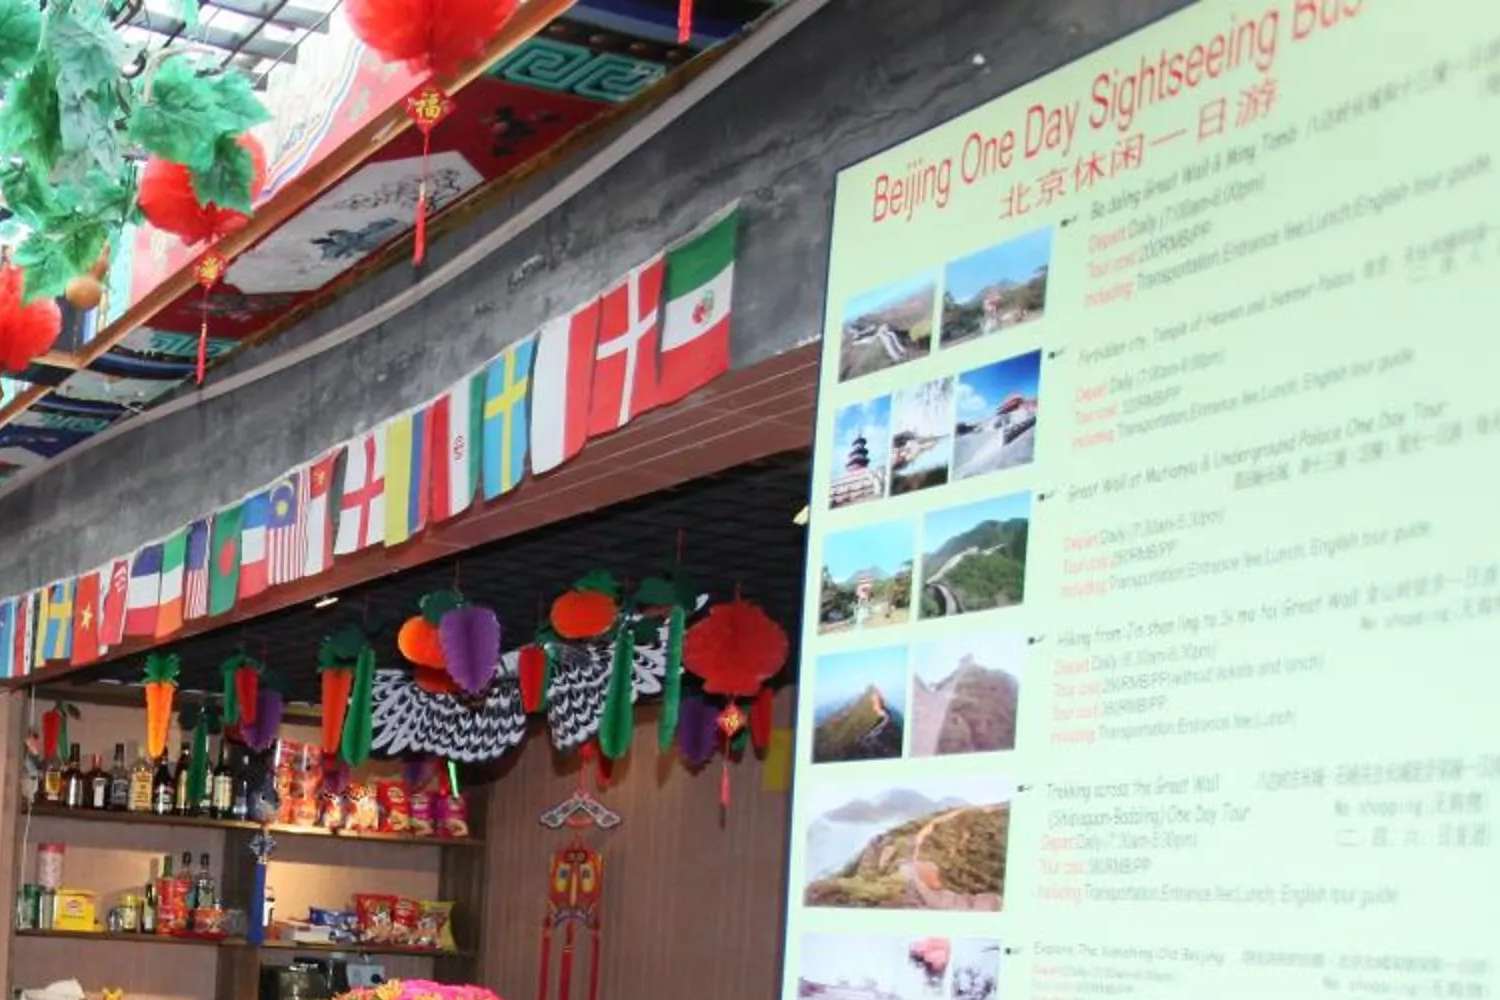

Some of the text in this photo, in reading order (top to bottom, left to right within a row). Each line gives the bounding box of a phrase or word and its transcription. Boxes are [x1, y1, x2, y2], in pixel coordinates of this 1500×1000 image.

[872, 156, 951, 223] Beijing
[961, 131, 1014, 185] One
[1024, 100, 1081, 158] Day
[1089, 9, 1280, 131] Sightseeing
